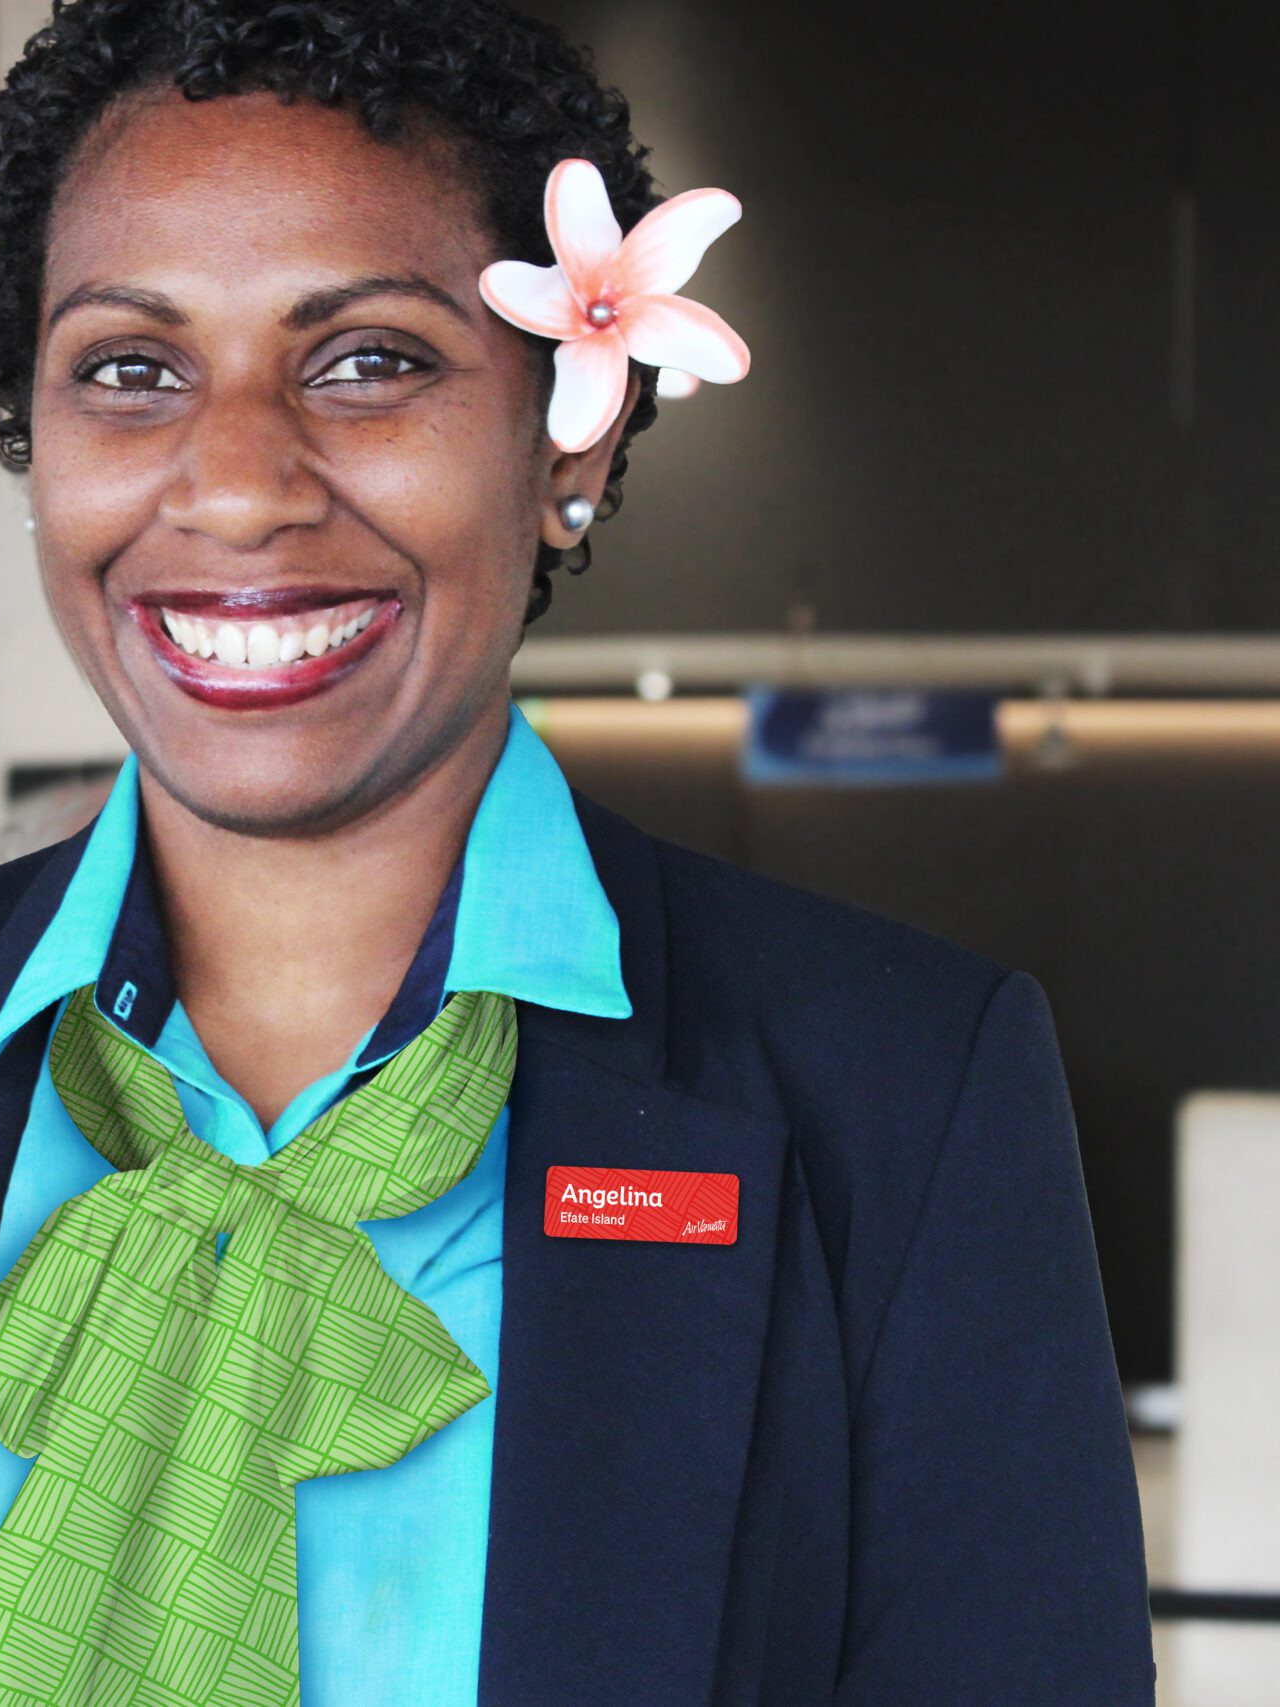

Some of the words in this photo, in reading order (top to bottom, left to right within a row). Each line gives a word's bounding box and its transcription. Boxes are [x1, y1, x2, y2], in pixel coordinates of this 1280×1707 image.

[561, 1184, 663, 1209] Angelina
[560, 1212, 589, 1224] Efate
[592, 1213, 625, 1226] Island
